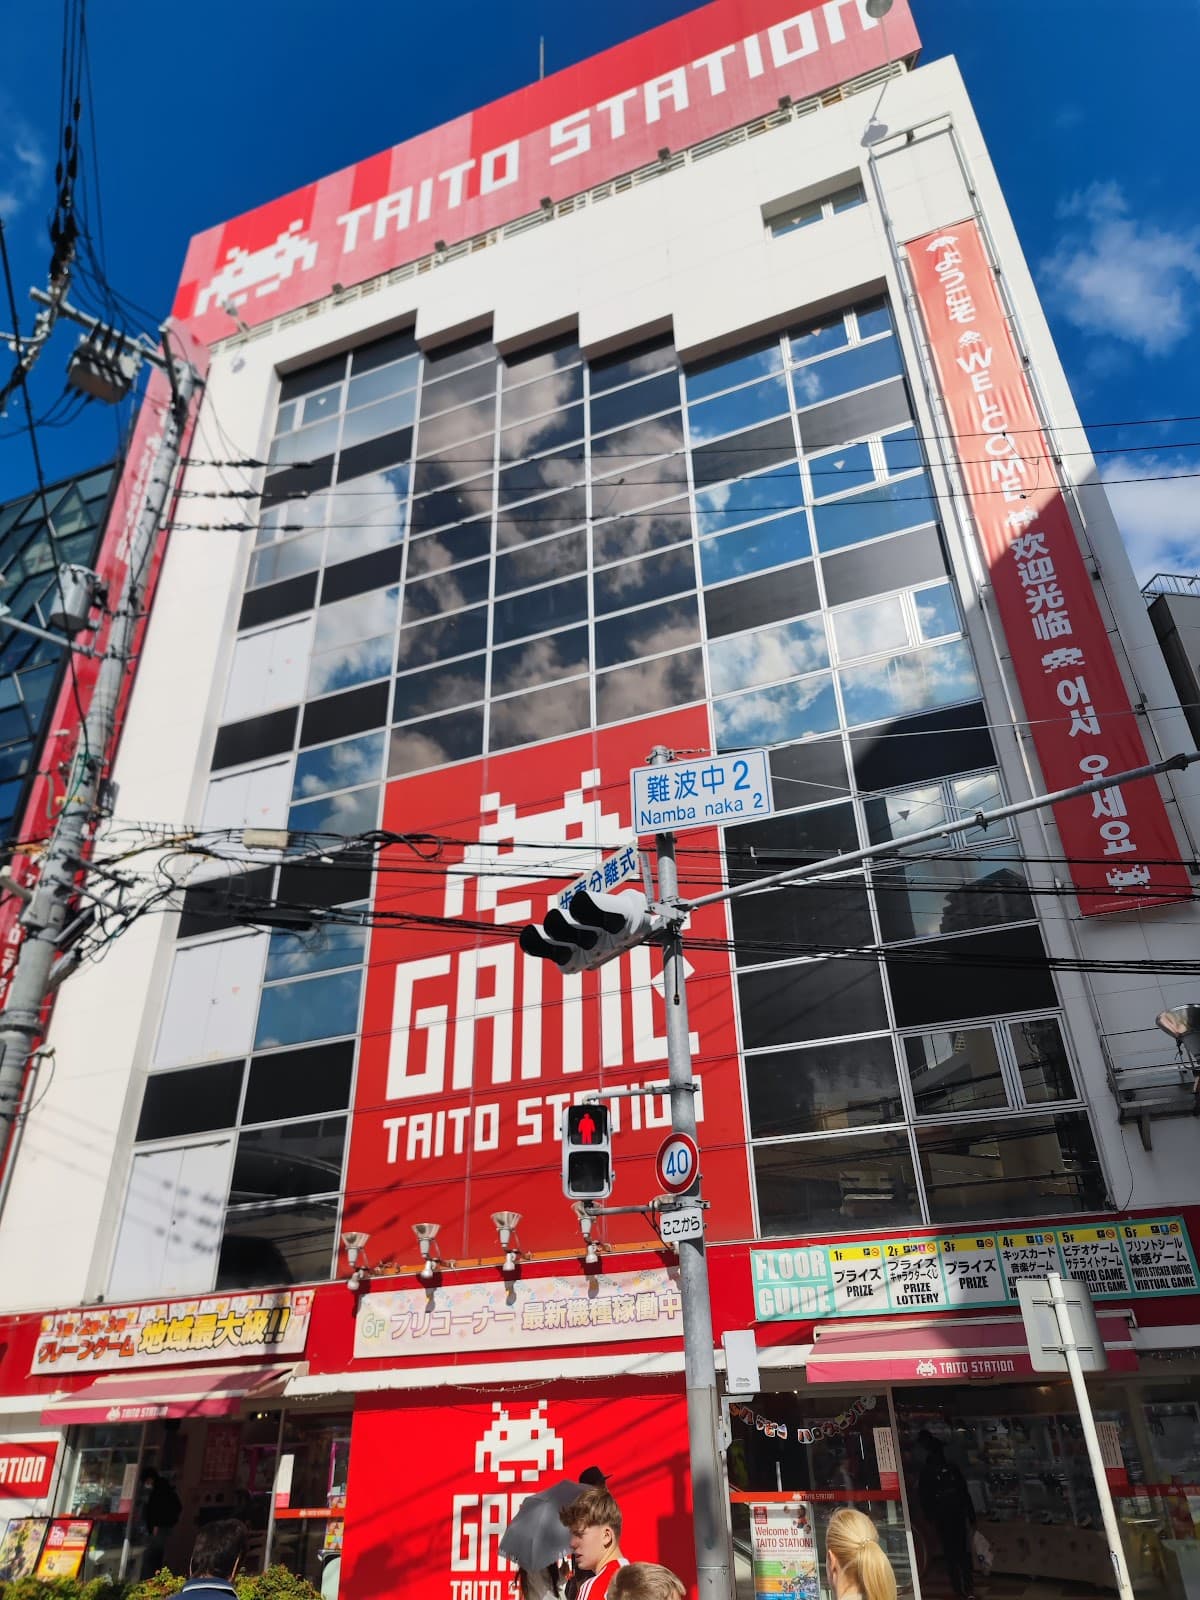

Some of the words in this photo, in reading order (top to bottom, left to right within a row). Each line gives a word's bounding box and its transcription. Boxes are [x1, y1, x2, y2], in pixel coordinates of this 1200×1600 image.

[336, 140, 520, 254] TAITO
[550, 0, 879, 166] STATION
[956, 347, 1026, 503] WELCOME
[1010, 532, 1074, 641] 欢迎光临
[1057, 676, 1101, 738] 어서
[647, 760, 751, 804] 難波中2
[641, 806, 696, 826] Namba
[705, 798, 743, 816] naka
[753, 792, 763, 808] 2
[383, 1103, 499, 1164] TAITO
[666, 1149, 688, 1176] 40
[663, 1216, 700, 1235] ここから
[1124, 1227, 1137, 1238] 6F
[1002, 1236, 1014, 1248] 4F
[1062, 1232, 1074, 1243] 5F
[1126, 1237, 1183, 1252] プリントシール
[887, 1246, 899, 1257] 2F
[943, 1241, 956, 1252] 3F
[1002, 1247, 1056, 1261] キッズカード
[1062, 1242, 1119, 1256] ビデオゲーム
[834, 1251, 843, 1261] 1F
[1065, 1255, 1124, 1270] サテライトゲーム
[1129, 1251, 1187, 1266] 体感ゲーム
[755, 1250, 826, 1281] FLOOR
[887, 1257, 937, 1271] プライズ
[945, 1258, 996, 1275] プライズ
[1010, 1260, 1054, 1274] 音楽ゲーム
[1131, 1267, 1149, 1278] PHOTO
[1149, 1266, 1171, 1277] STICKER
[1171, 1264, 1192, 1275] BOOTHS
[834, 1267, 882, 1283] プライズ
[959, 1276, 989, 1289] PRIZE
[1071, 1270, 1097, 1282] VIDEO
[1098, 1268, 1124, 1281] GAME
[846, 1285, 874, 1297] PRIZE
[903, 1282, 931, 1294] PRIZE
[1108, 1281, 1128, 1292] GAME
[1134, 1278, 1170, 1291] VIRTUAL
[1171, 1276, 1196, 1288] GAME
[758, 1285, 832, 1317] GUIDE
[896, 1293, 939, 1306] LOTTERY
[391, 1306, 516, 1340] プリコーナー
[522, 1289, 682, 1330] 最新機種稼働中
[362, 1313, 385, 1338] 6F
[39, 1335, 135, 1364] クレーンゲーム
[939, 1361, 968, 1374] TAITO
[971, 1360, 1015, 1372] STATION
[755, 1527, 789, 1536] Welcome
[790, 1527, 798, 1536] to
[755, 1538, 777, 1548] TAITO
[778, 1538, 814, 1548] STATION!
[450, 1581, 502, 1600] TAITO
